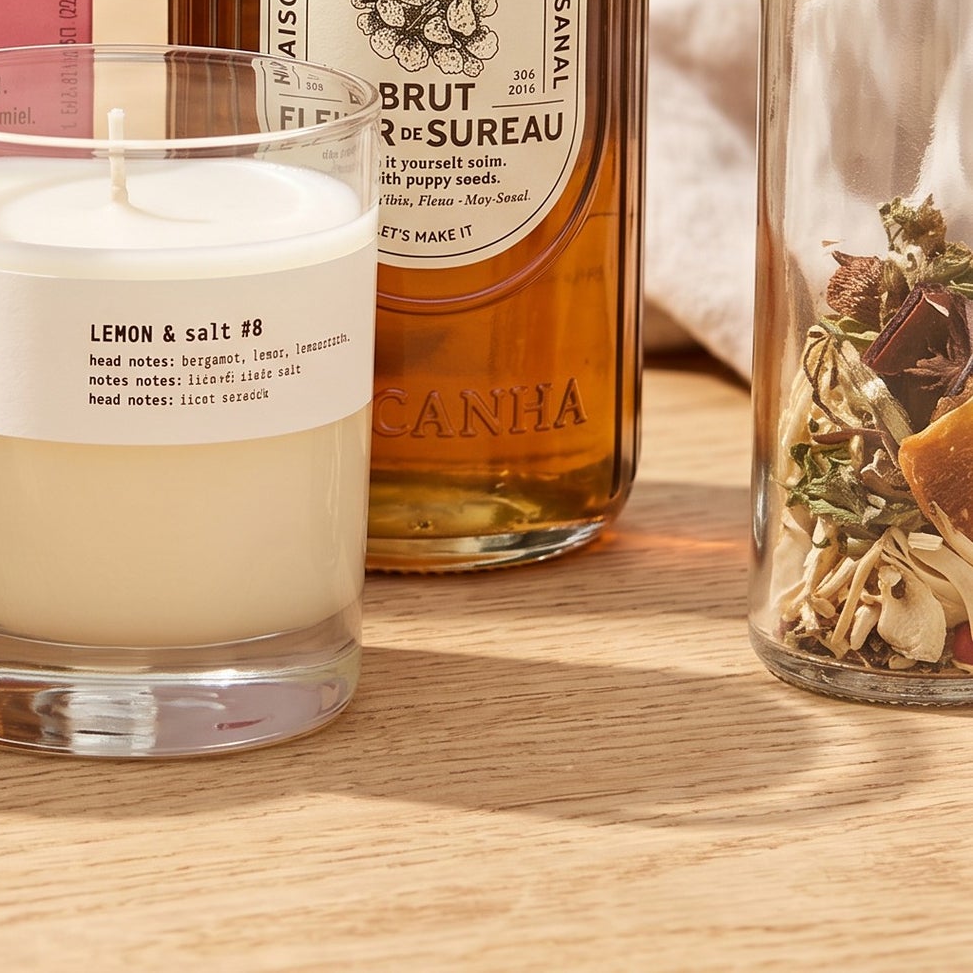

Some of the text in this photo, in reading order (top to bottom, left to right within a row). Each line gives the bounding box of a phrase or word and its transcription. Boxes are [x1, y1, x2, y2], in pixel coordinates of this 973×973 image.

[513, 69, 536, 80] 306
[378, 82, 476, 112] BRUT
[508, 84, 536, 95] 2016
[400, 127, 423, 140] DE
[426, 112, 564, 148] SUREAU
[385, 156, 397, 169] it
[406, 174, 452, 190] puppy
[378, 225, 472, 243] ET'S MAKE IT
[90, 319, 263, 343] LEMON & salt #8
[89, 354, 121, 367] head
[129, 355, 175, 368] notes:
[182, 353, 246, 369] bergamot,
[89, 374, 128, 386] notes
[136, 375, 182, 387] notes:
[88, 393, 121, 405] head
[128, 394, 174, 406] notes:
[372, 377, 588, 438] CANHA
